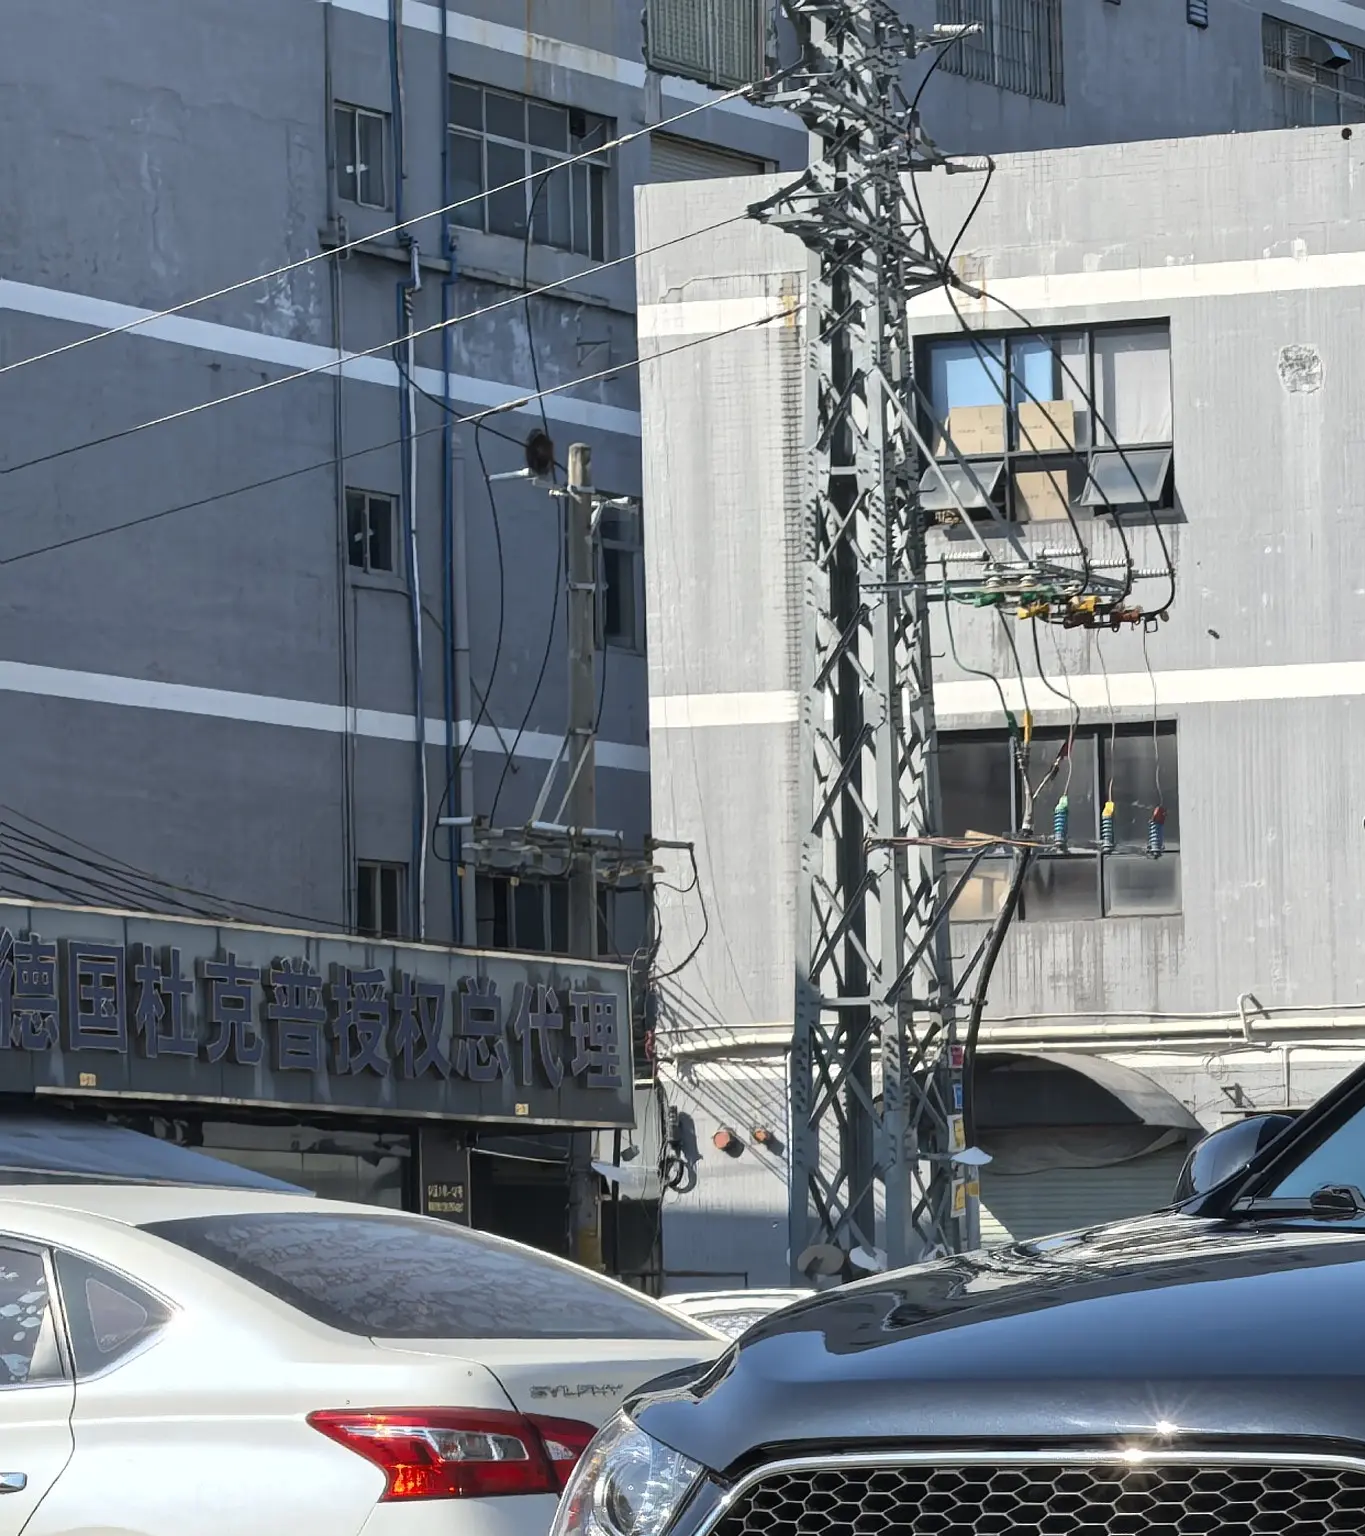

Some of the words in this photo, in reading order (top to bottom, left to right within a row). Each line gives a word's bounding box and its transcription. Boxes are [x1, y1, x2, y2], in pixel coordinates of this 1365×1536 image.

[0, 926, 623, 1089] 德国杜克普授权总代理
